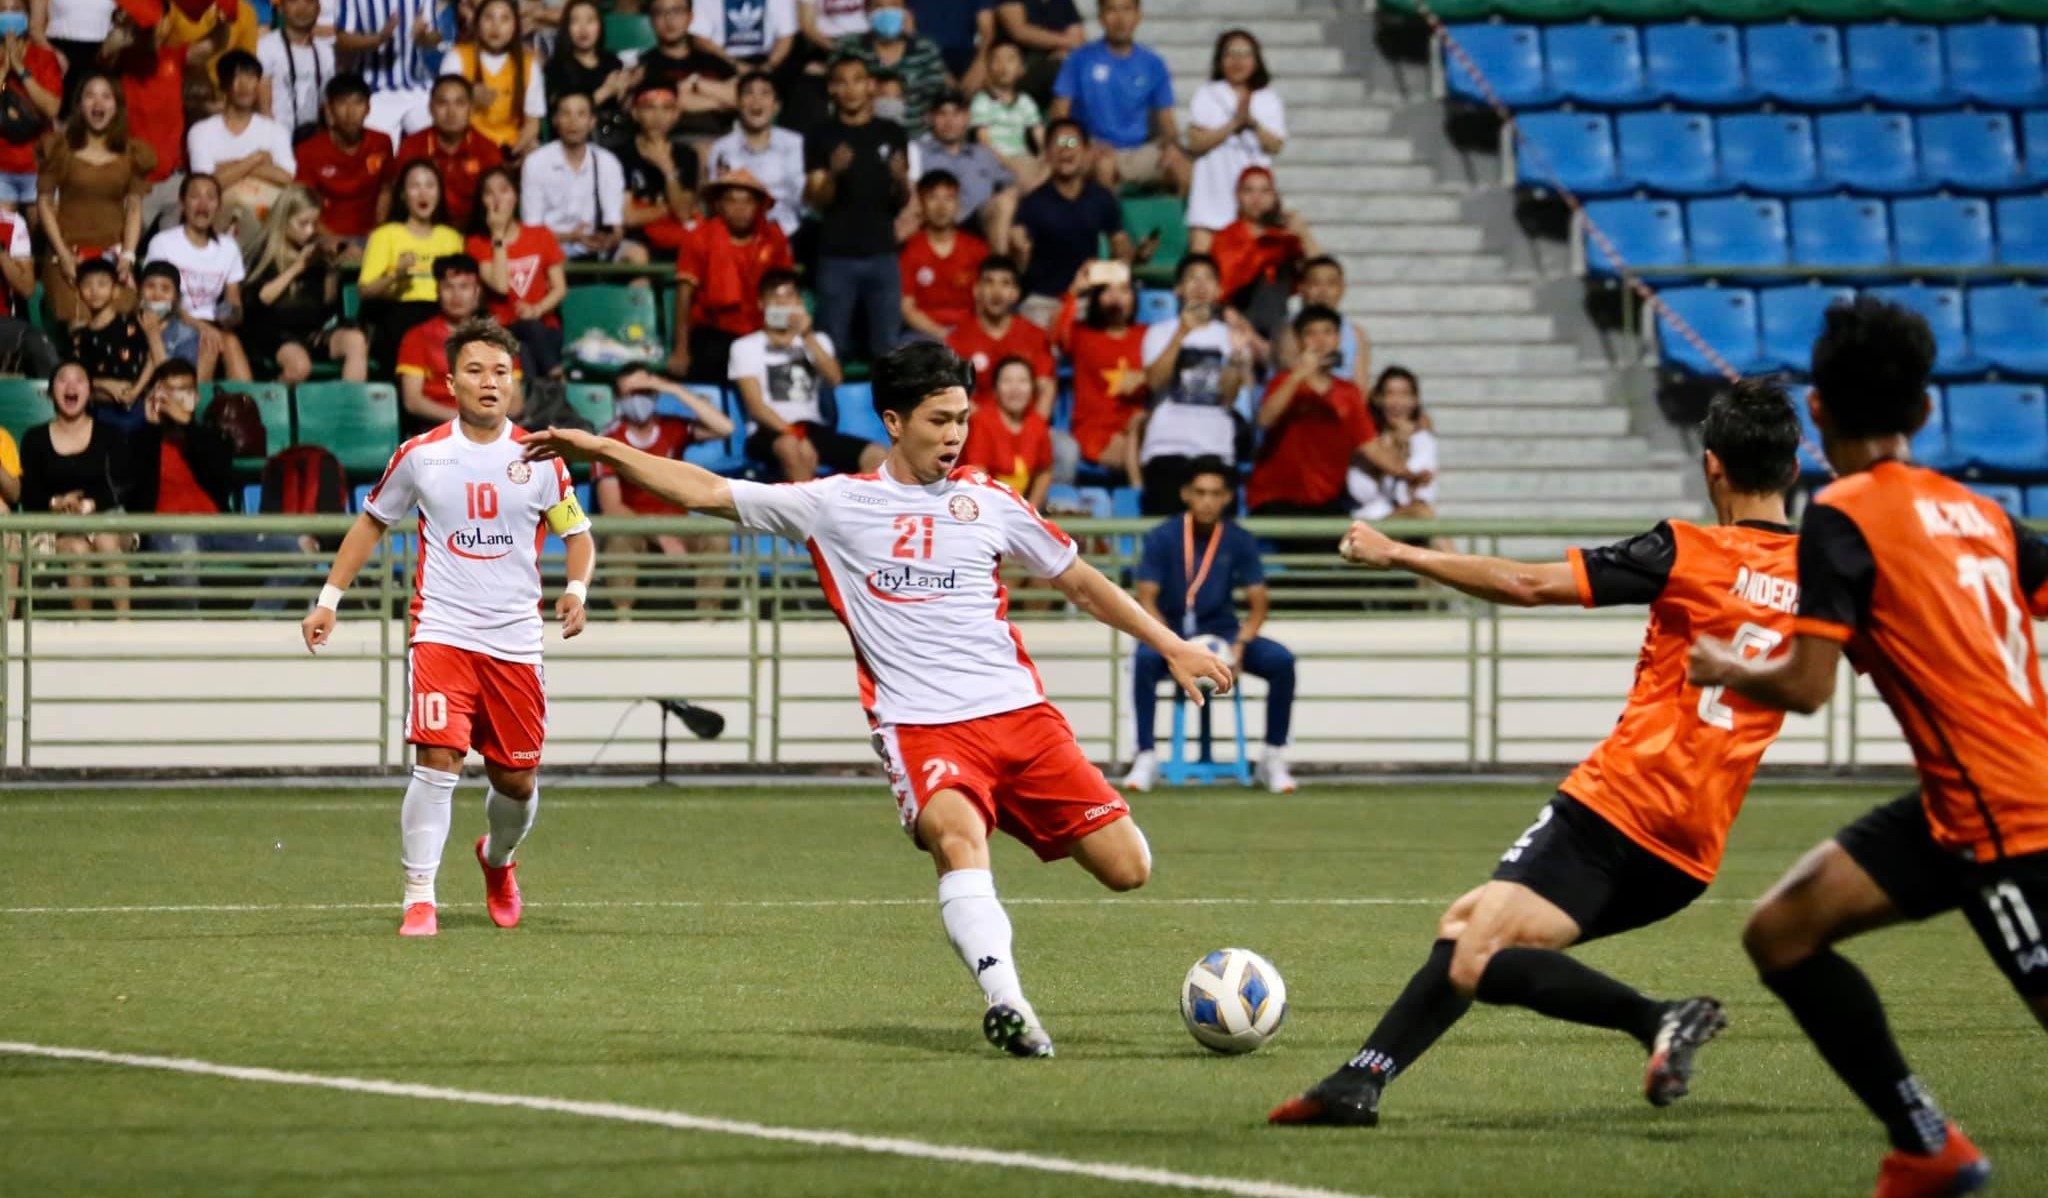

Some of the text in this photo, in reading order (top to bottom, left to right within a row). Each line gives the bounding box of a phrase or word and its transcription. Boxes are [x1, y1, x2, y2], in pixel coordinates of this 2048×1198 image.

[466, 482, 498, 520] 10
[892, 514, 933, 560] 21
[417, 692, 448, 731] 10
[1513, 804, 1554, 848] 2
